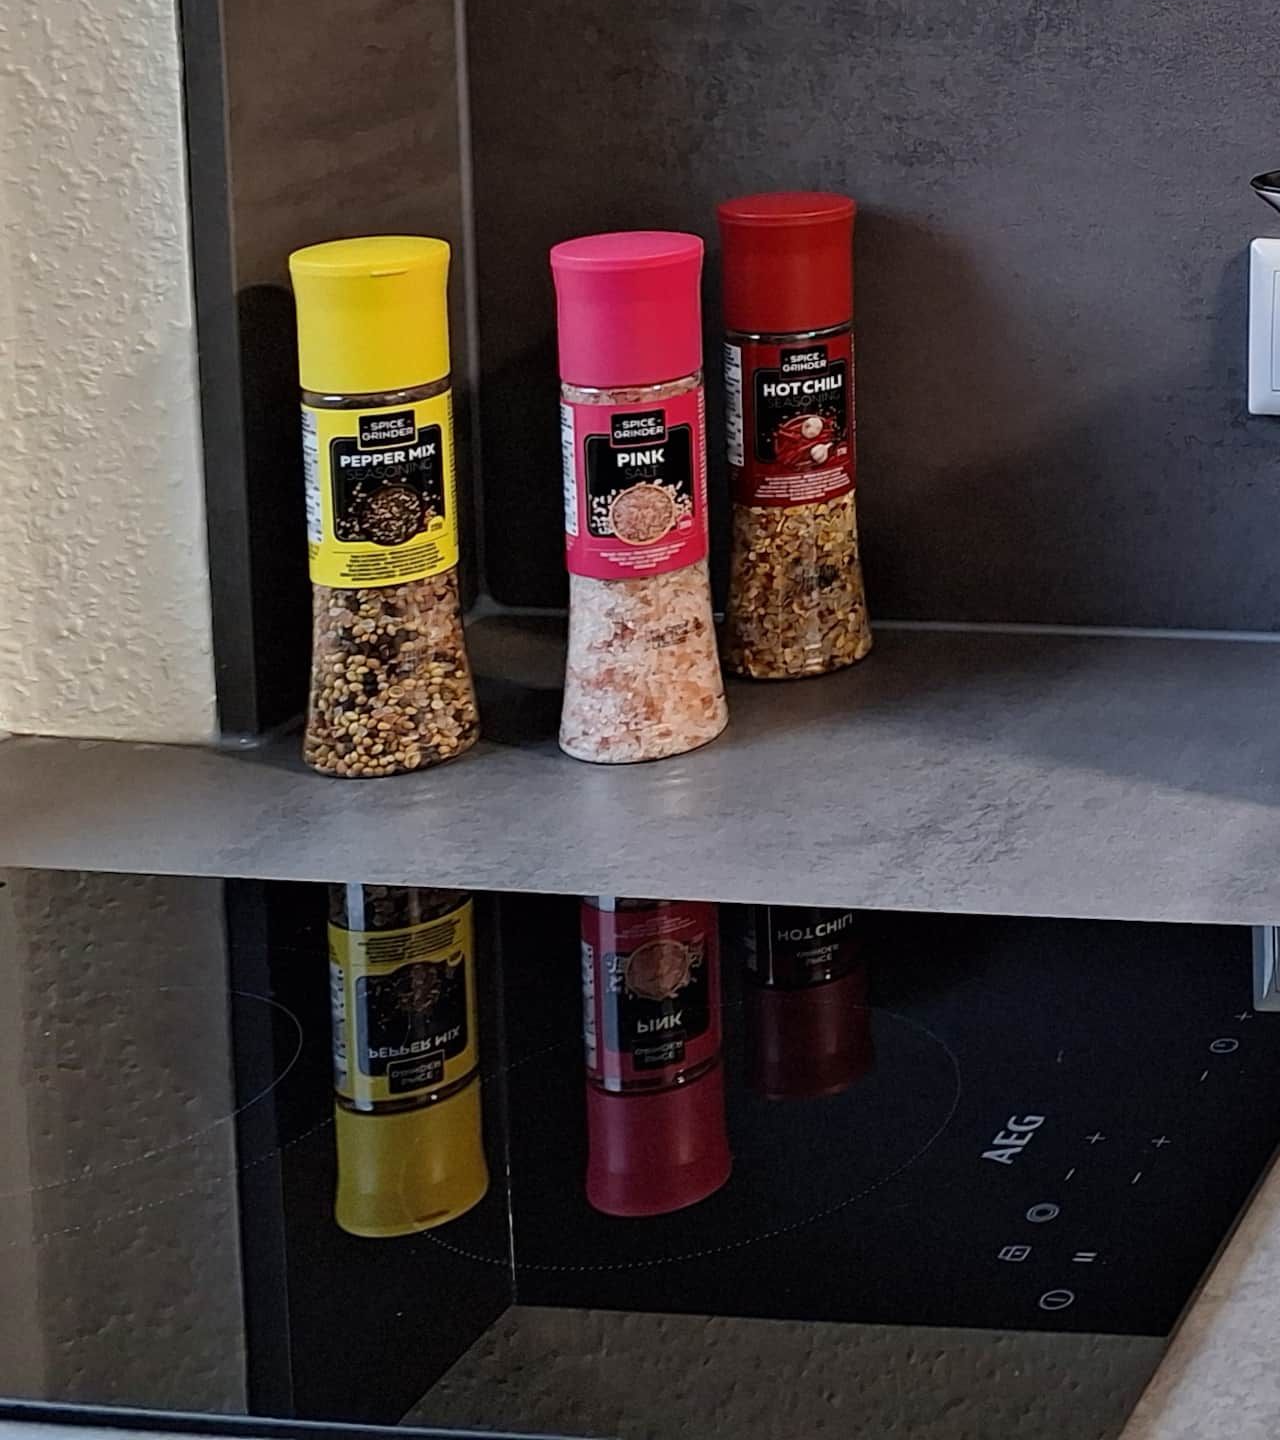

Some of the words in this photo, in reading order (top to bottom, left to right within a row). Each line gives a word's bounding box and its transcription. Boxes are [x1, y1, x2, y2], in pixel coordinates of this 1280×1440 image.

[789, 352, 820, 363] SPICE
[763, 381, 801, 397] HOT
[802, 374, 842, 394] CHILI
[370, 418, 406, 431] SPICE
[622, 417, 657, 429] SPICE
[362, 427, 414, 441] GRINDER
[614, 426, 665, 440] GRINDER
[340, 450, 406, 468] PEPPER
[408, 443, 436, 459] MIX
[617, 449, 665, 468] PINK
[981, 1115, 1045, 1165] AEG
